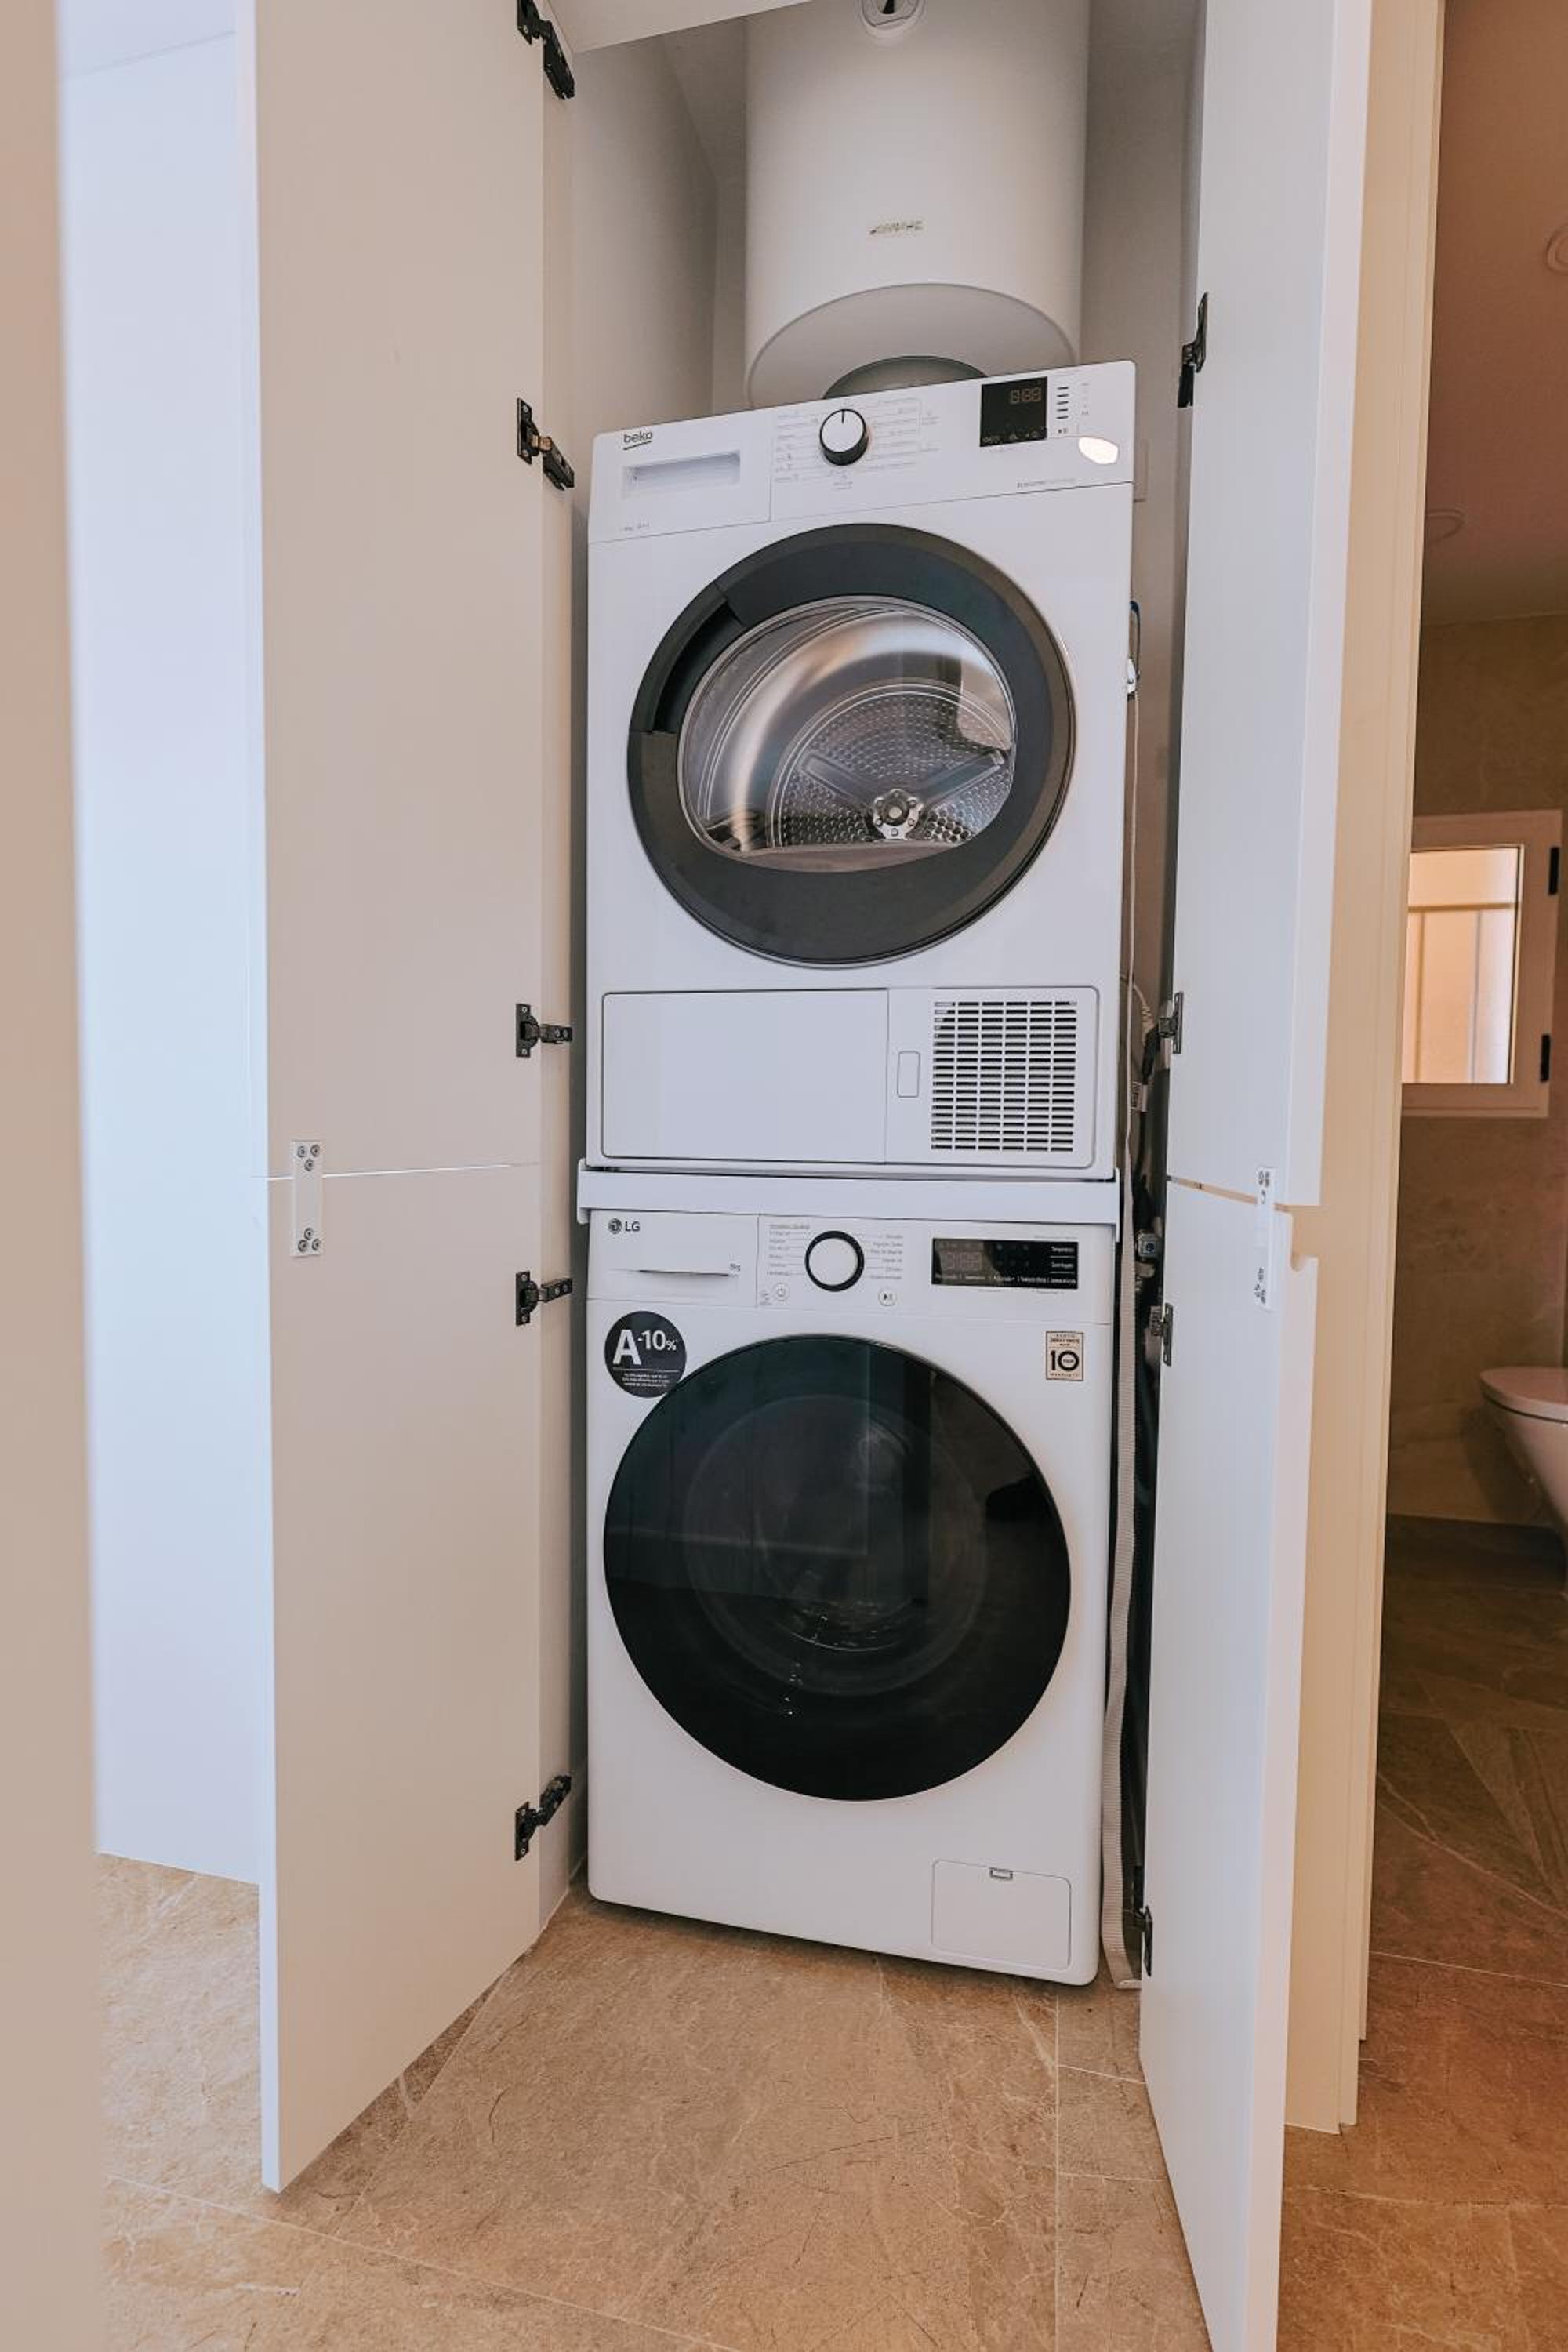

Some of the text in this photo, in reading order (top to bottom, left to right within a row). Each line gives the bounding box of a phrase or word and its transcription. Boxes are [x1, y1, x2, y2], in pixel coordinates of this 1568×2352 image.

[624, 431, 652, 443] beko
[625, 1221, 641, 1232] LG
[1051, 1350, 1080, 1371] 10
